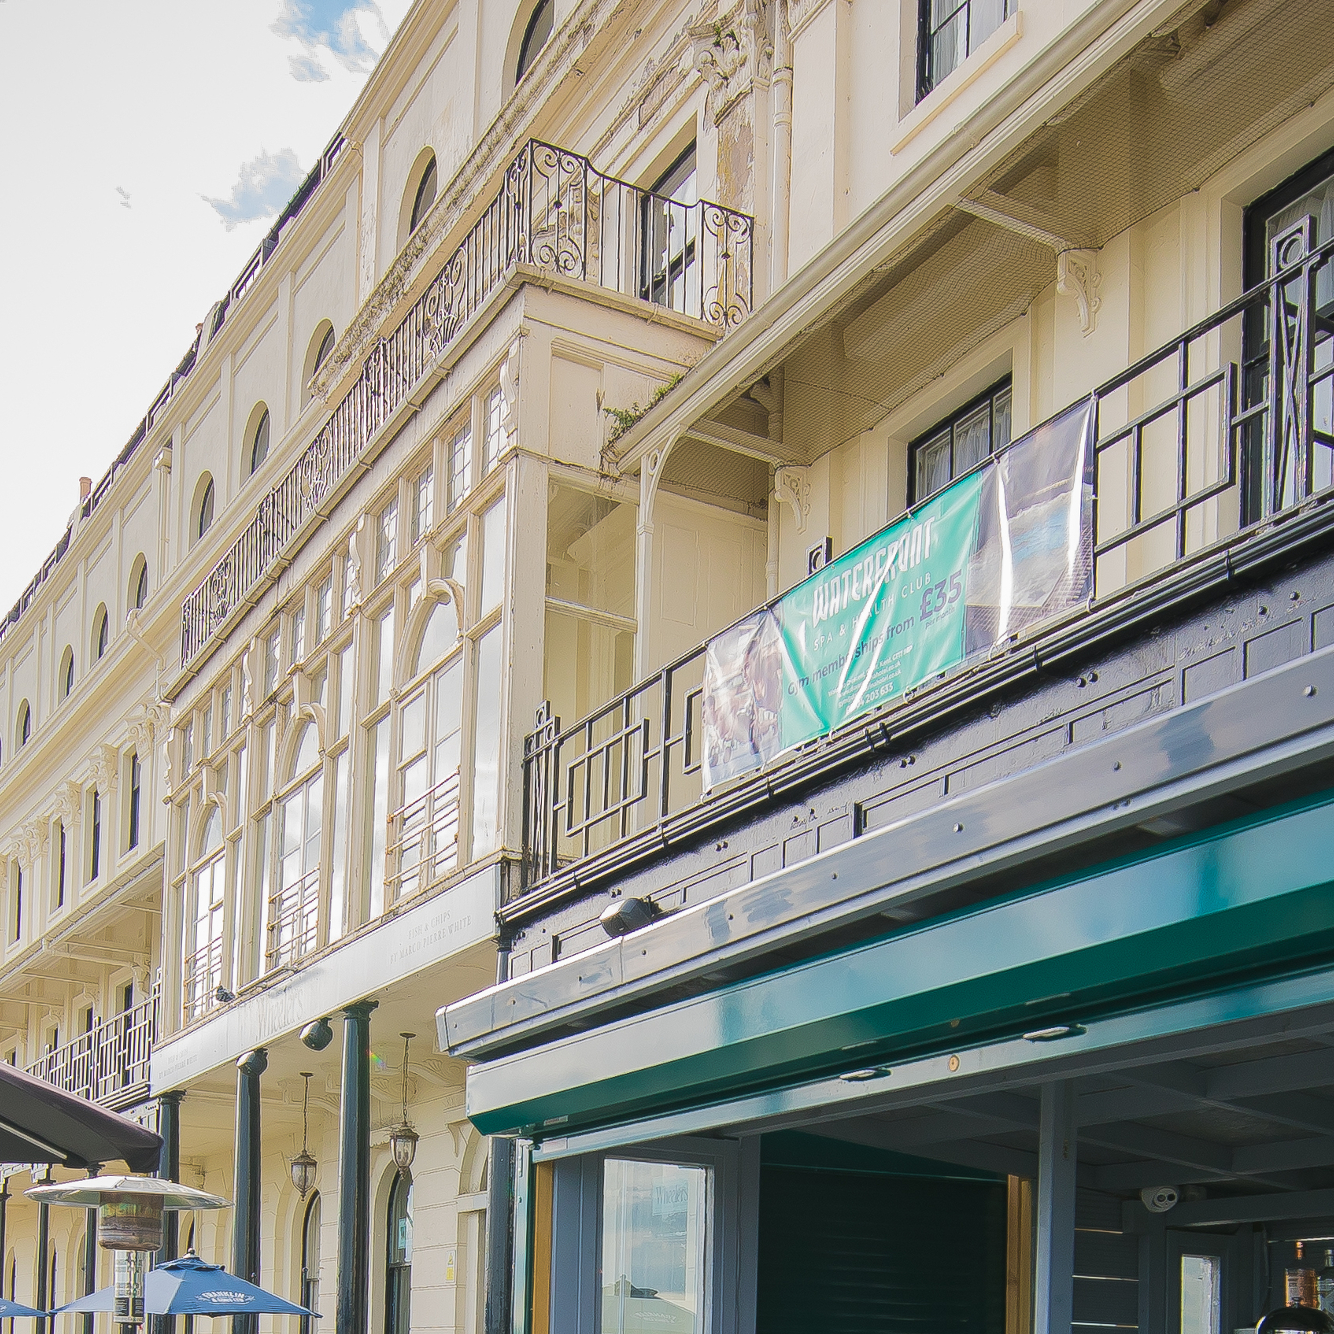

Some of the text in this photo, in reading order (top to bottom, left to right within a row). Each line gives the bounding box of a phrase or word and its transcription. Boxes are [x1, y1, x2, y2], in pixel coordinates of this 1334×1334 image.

[812, 516, 935, 629] WATERFRONT
[886, 616, 915, 641] from
[919, 568, 962, 622] £35
[813, 632, 833, 651] SPA
[839, 624, 846, 637] &
[901, 572, 931, 598] CLUB
[400, 943, 421, 959] MARCO
[423, 928, 446, 948] PIERRE
[448, 915, 472, 935] WHITE
[431, 910, 451, 928] CHIPS
